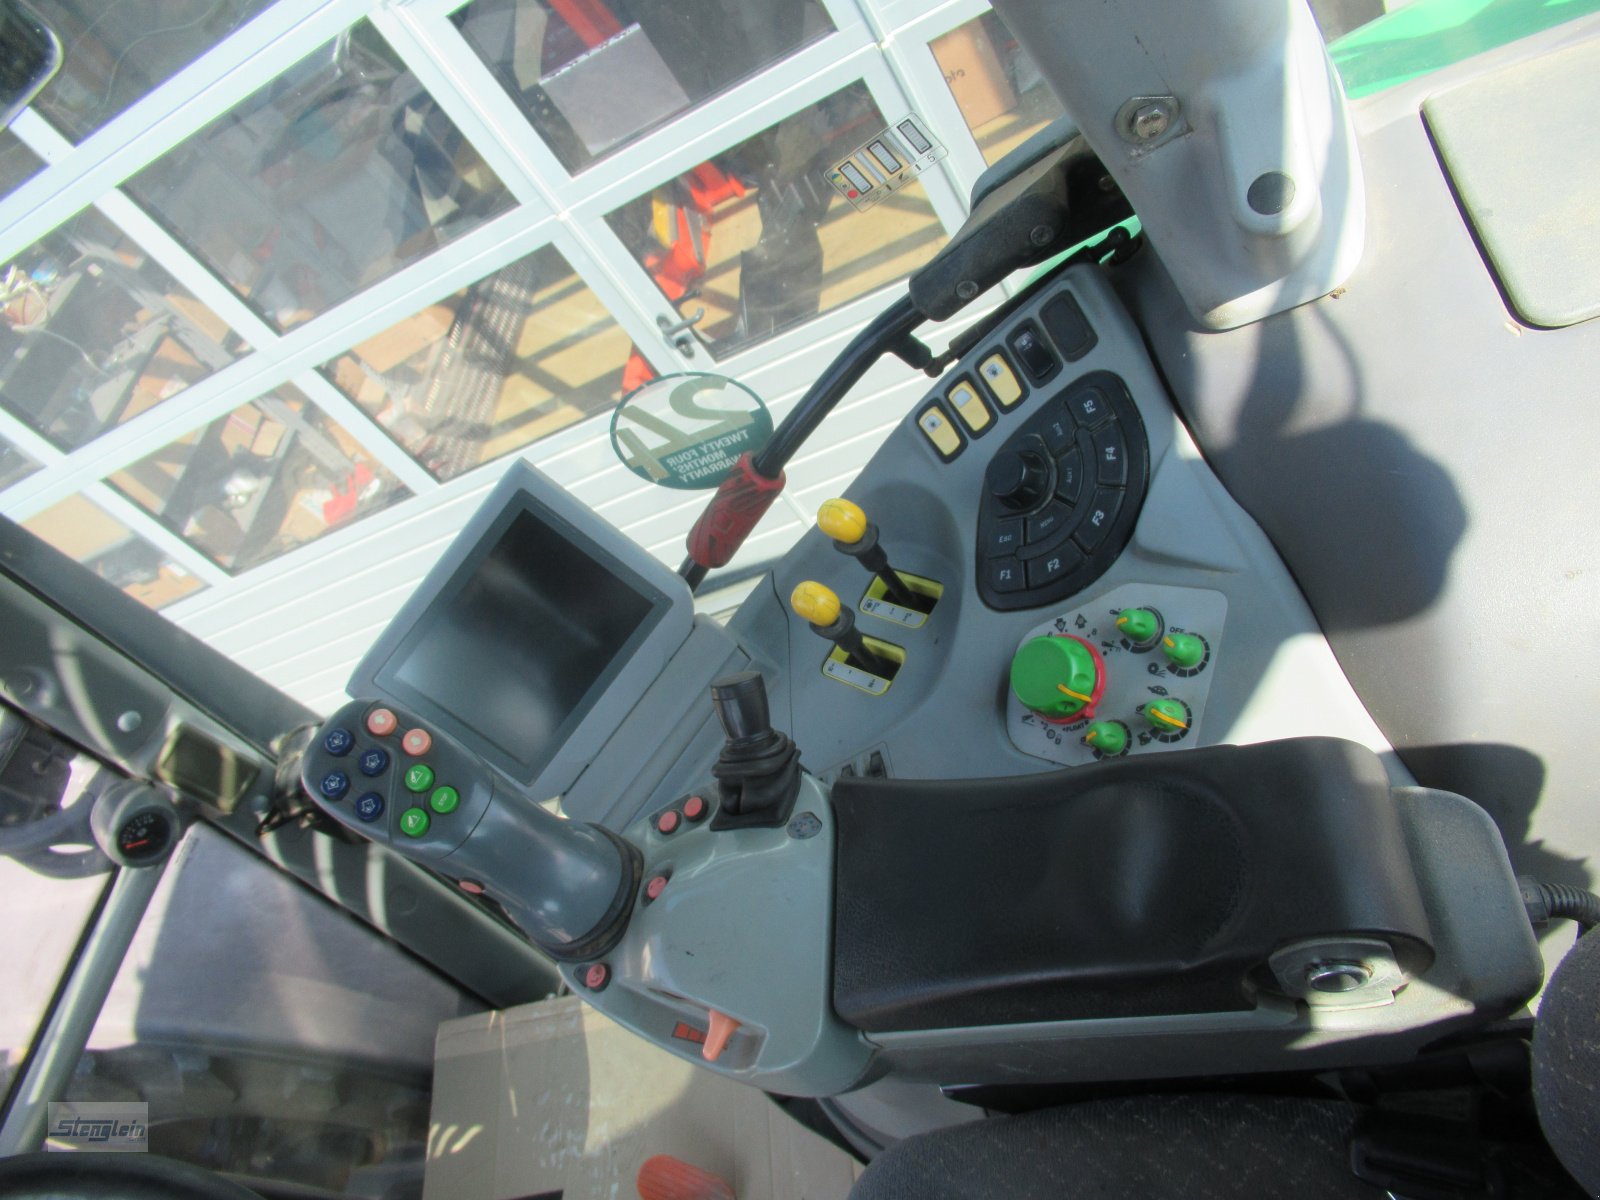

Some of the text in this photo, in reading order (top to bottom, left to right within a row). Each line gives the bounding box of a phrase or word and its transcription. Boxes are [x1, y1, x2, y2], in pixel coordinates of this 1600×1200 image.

[1083, 399, 1097, 414] F5
[1105, 446, 1117, 461] F4
[1091, 509, 1105, 526] F3
[1047, 558, 1060, 573] F2
[1000, 570, 1012, 581] F1
